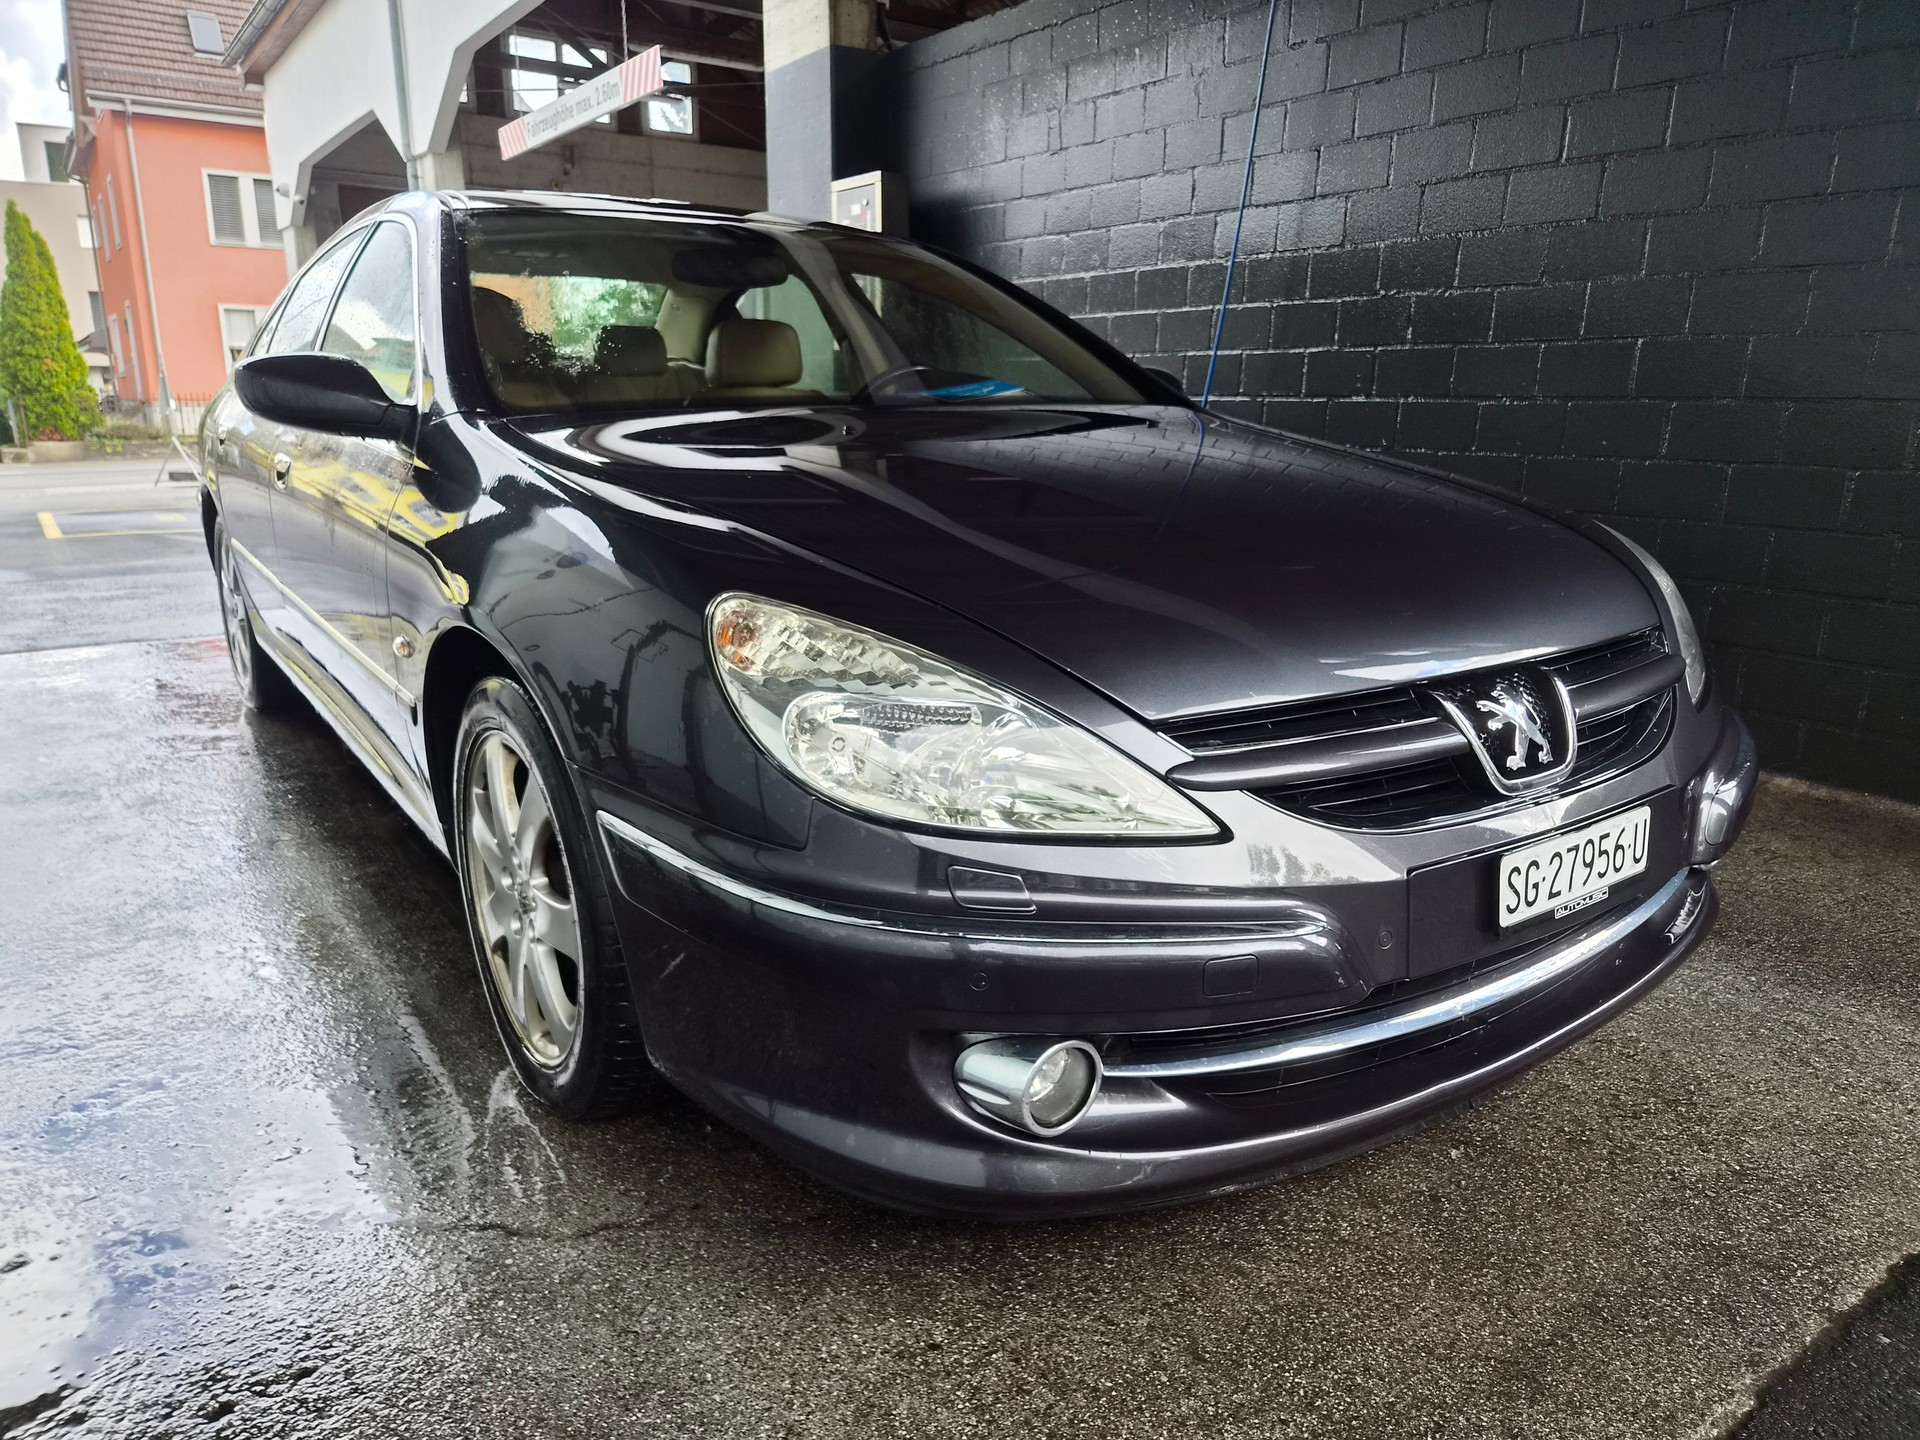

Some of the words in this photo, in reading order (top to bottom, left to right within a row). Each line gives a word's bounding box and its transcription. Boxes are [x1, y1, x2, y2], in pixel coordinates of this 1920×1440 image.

[526, 103, 575, 140] Fahrzeughöhe
[575, 96, 595, 118] max.
[595, 81, 621, 107] 2.60m
